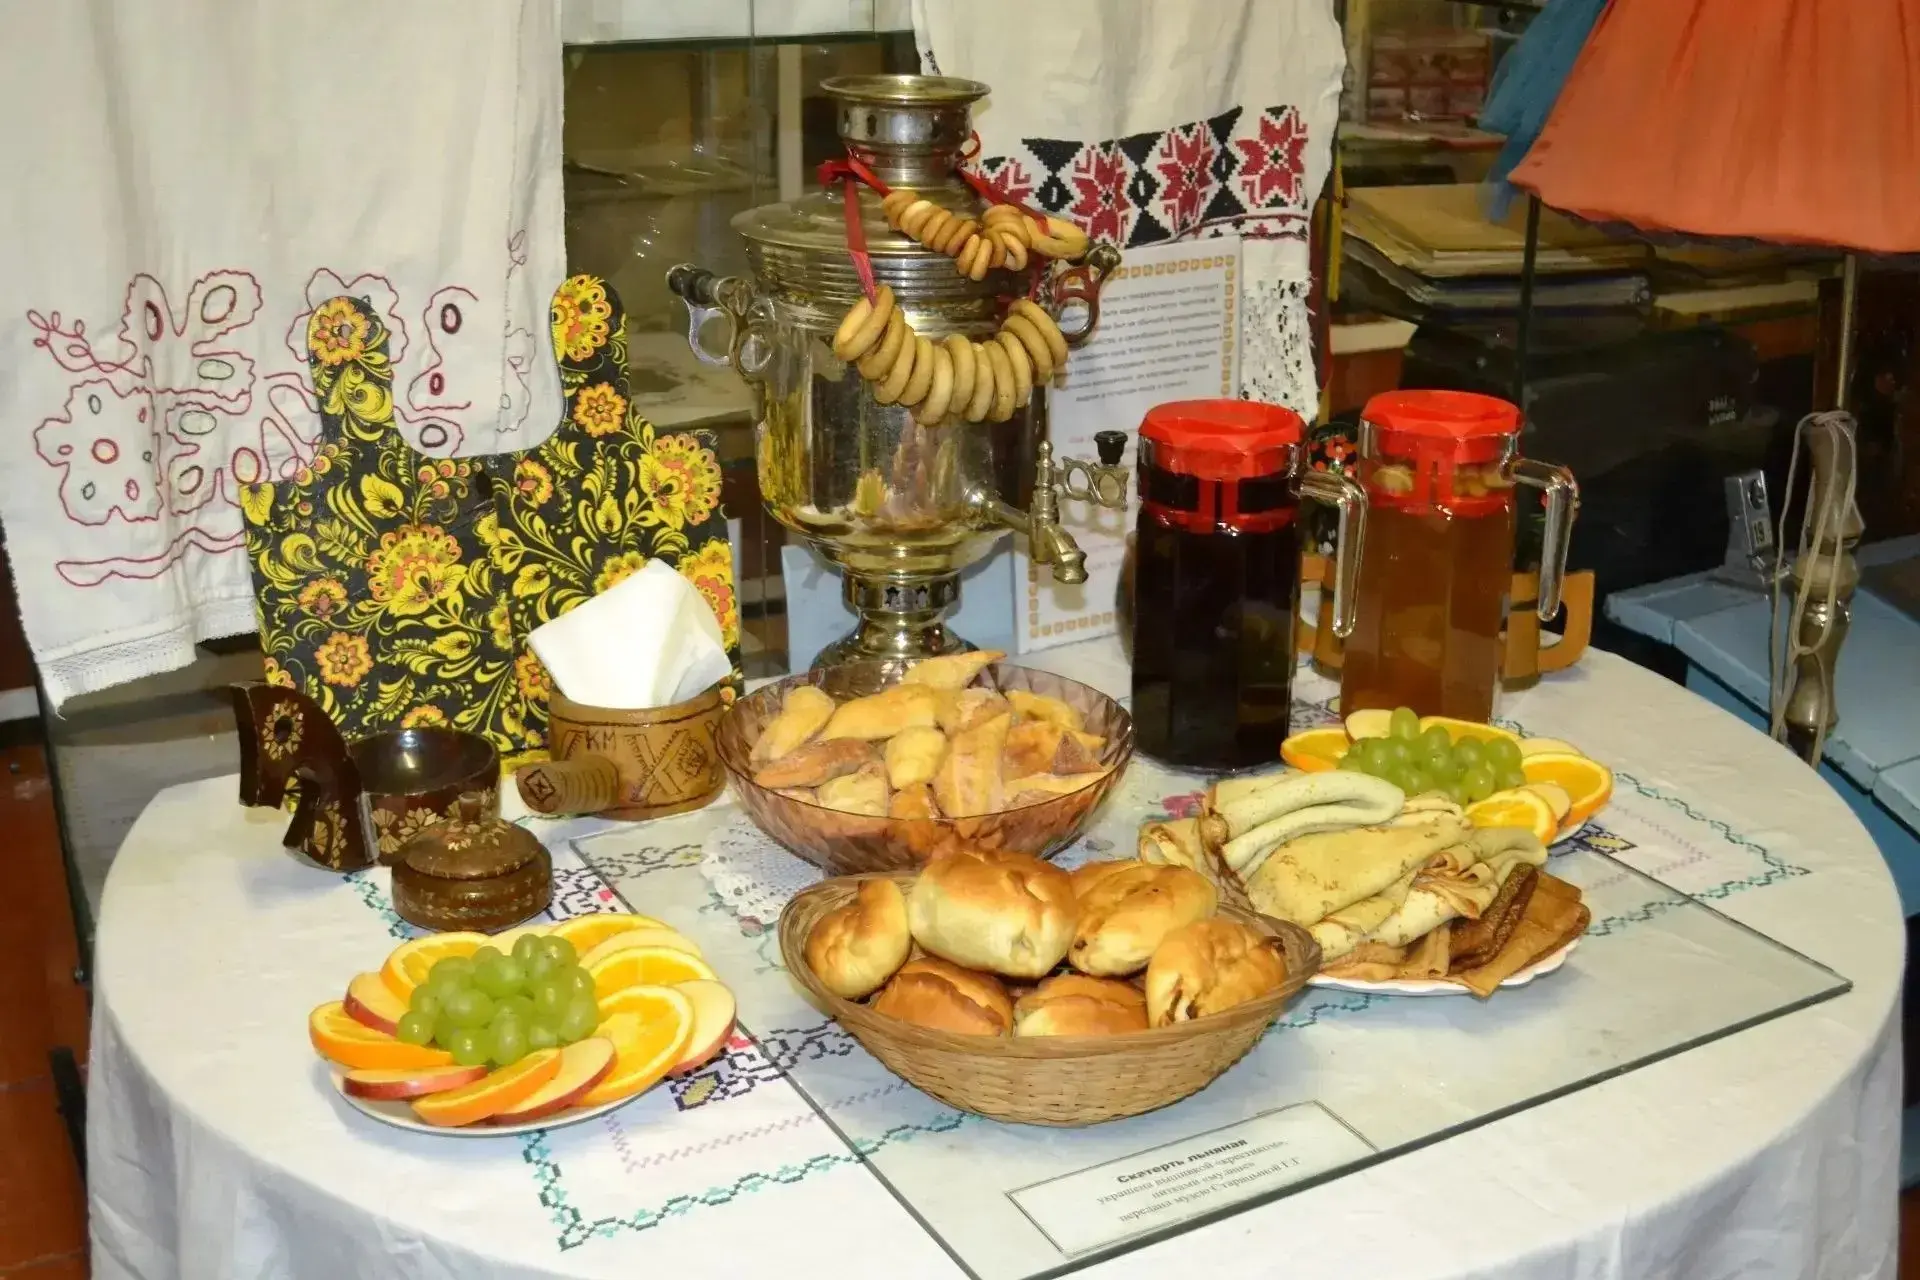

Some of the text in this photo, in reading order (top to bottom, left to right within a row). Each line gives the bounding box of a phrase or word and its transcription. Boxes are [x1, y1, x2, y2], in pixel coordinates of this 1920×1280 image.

[1117, 1139, 1248, 1182] Скатерть льняная
[1097, 1183, 1153, 1204] украшена
